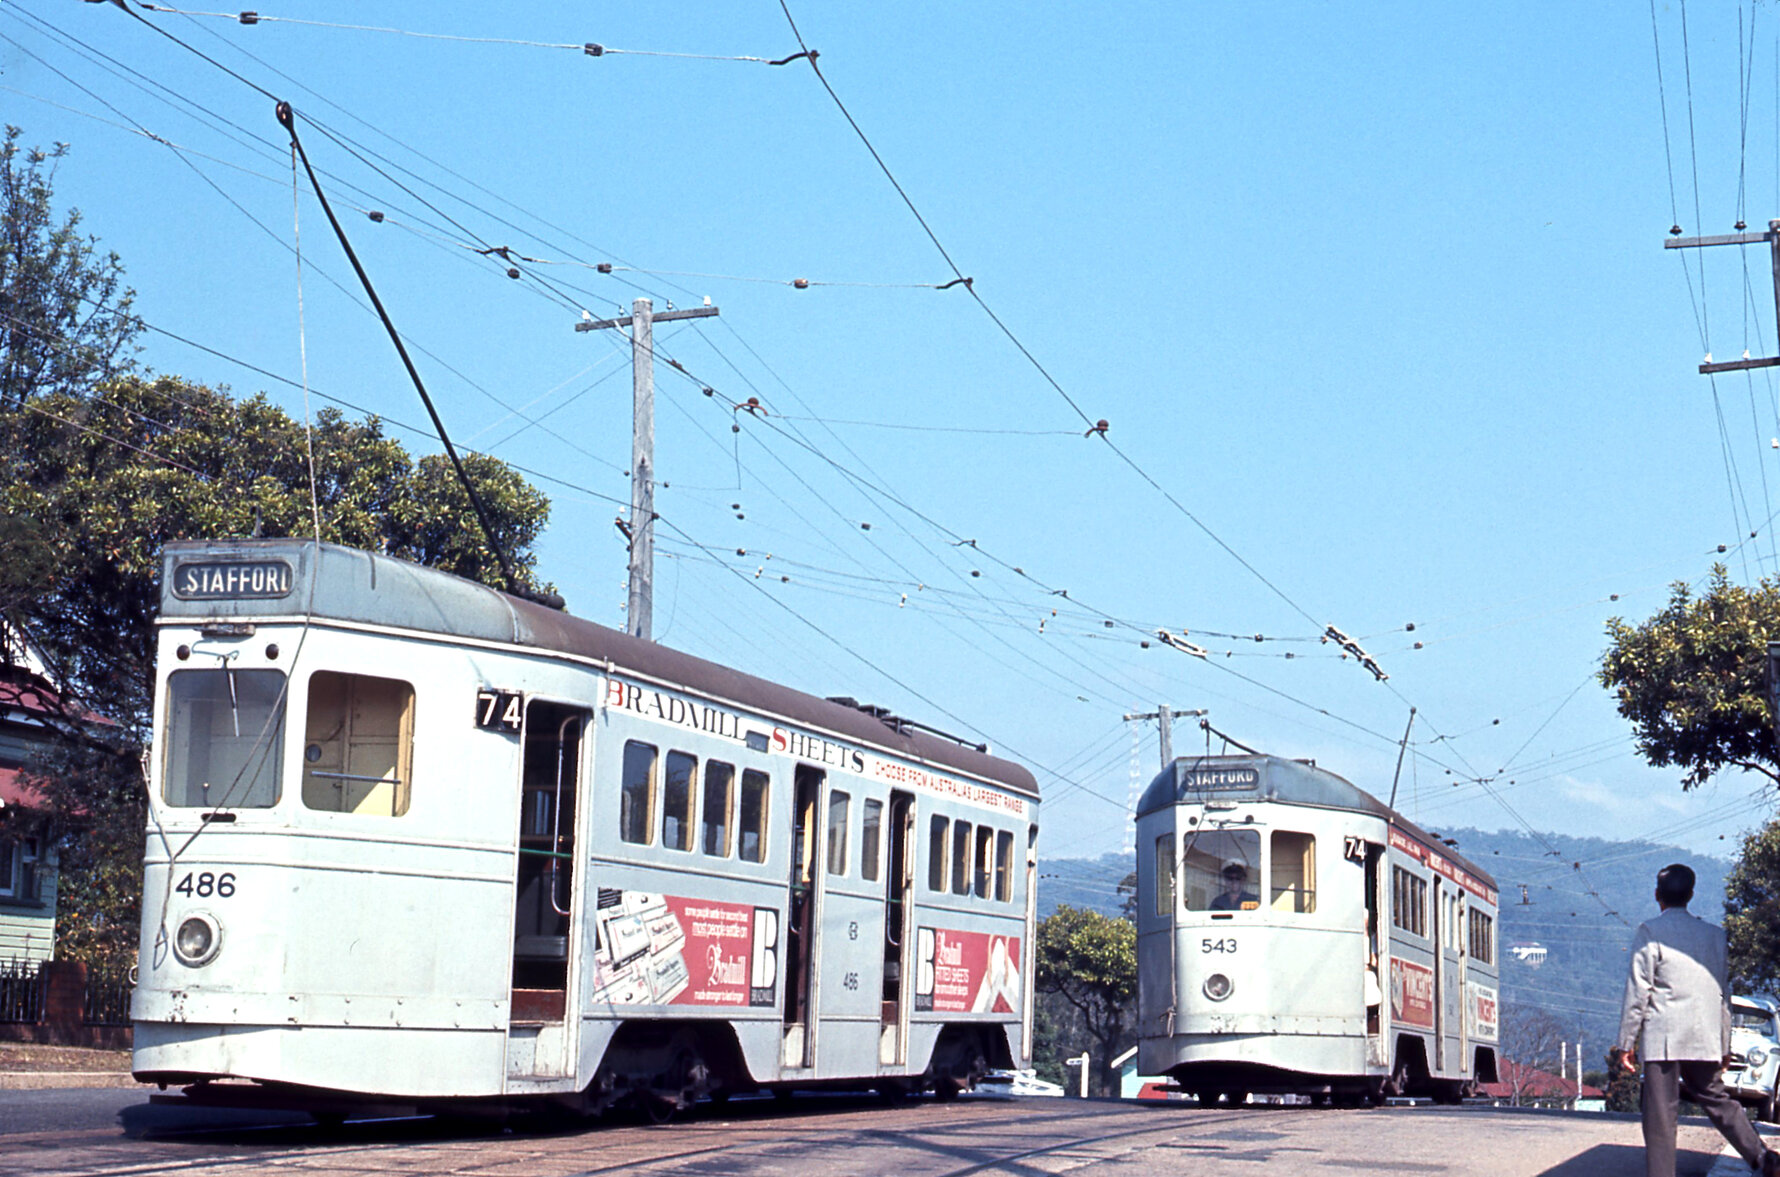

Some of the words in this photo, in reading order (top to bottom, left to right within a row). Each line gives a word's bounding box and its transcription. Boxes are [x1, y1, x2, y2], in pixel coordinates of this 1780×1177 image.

[478, 692, 522, 729] 74
[608, 678, 747, 741] BRADMILL
[772, 726, 865, 774] SHEETS
[875, 761, 906, 782] CHOOSE
[908, 769, 927, 787] FROM
[973, 787, 1003, 808] LARGEST
[1004, 795, 1024, 814] RANGE
[1345, 837, 1366, 860] 74
[175, 871, 237, 898] 486
[1201, 938, 1237, 954] 543
[843, 971, 859, 991] 486
